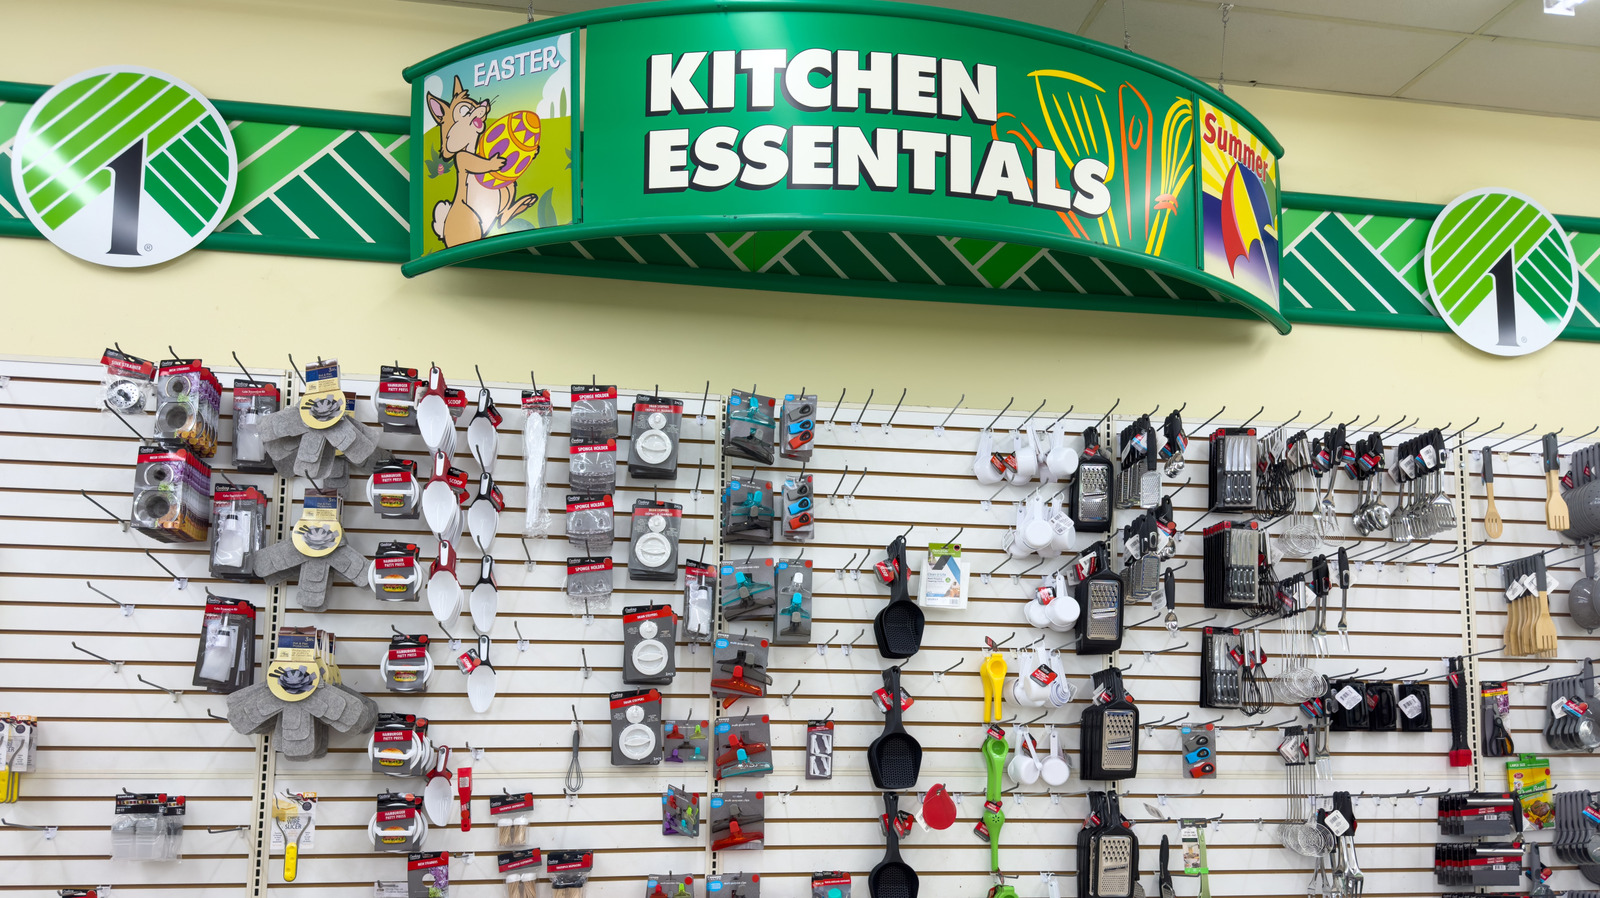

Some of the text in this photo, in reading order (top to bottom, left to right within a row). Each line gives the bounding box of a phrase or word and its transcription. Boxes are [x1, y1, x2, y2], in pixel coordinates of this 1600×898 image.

[474, 46, 560, 87] EASTER
[646, 48, 997, 123] KITCHEN
[644, 124, 1111, 219] ESSENTIALS
[1203, 112, 1268, 183] Summer
[449, 478, 463, 486] SCOOP
